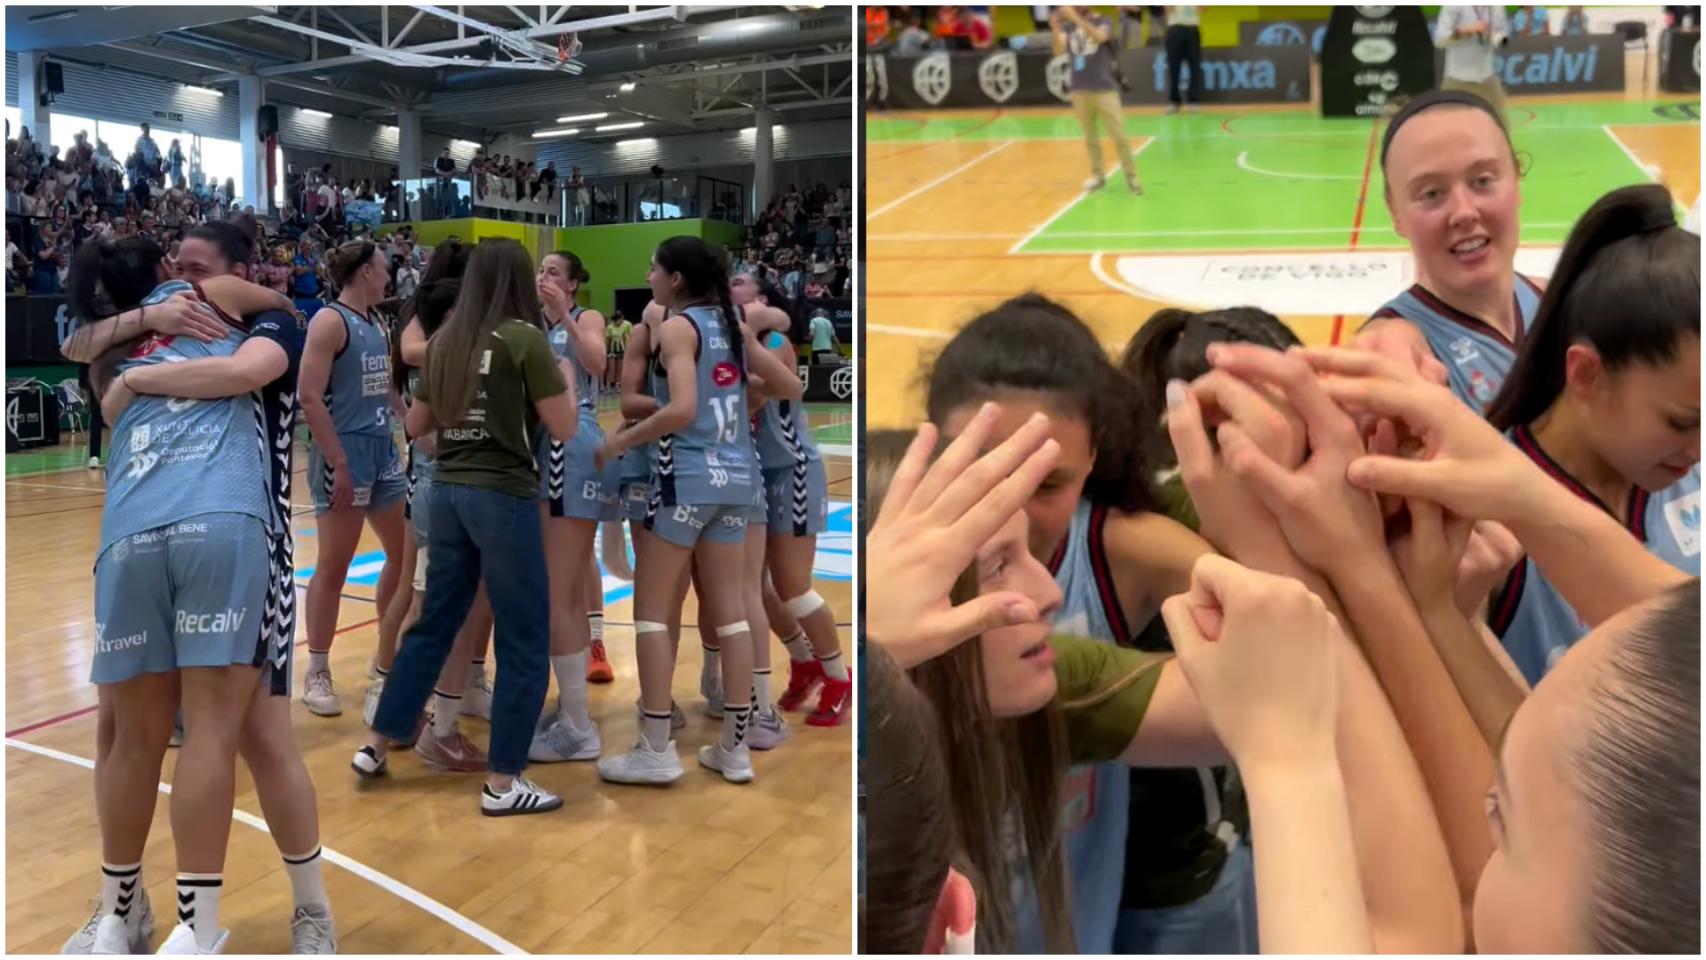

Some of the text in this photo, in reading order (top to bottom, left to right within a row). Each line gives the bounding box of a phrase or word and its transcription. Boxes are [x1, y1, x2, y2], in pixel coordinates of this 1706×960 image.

[1492, 45, 1599, 85] ecalvi
[708, 394, 740, 444] 15
[178, 523, 208, 534] BENE
